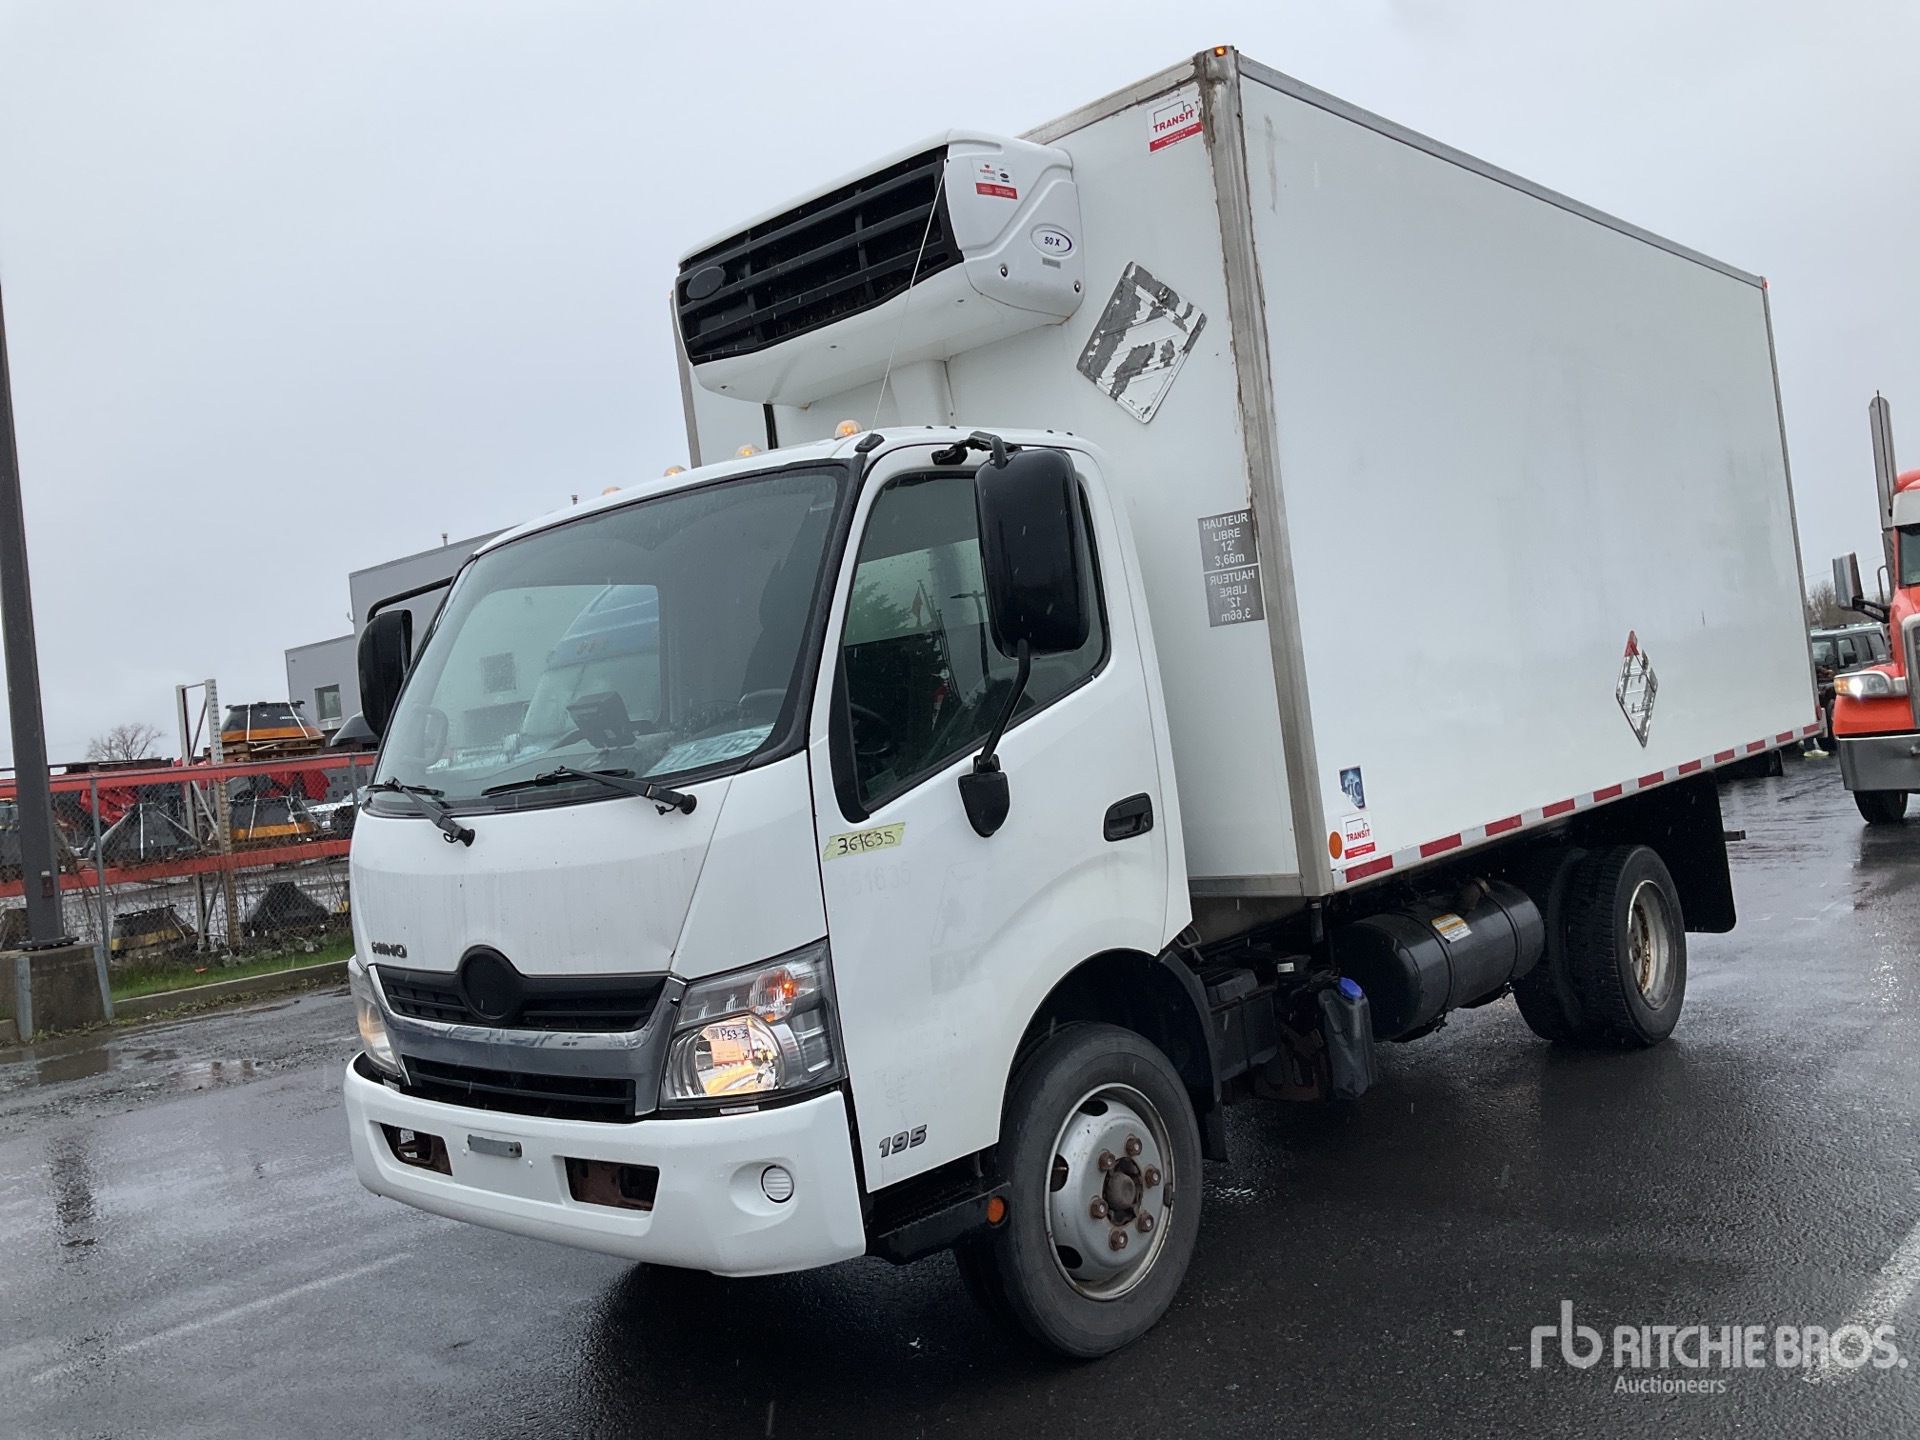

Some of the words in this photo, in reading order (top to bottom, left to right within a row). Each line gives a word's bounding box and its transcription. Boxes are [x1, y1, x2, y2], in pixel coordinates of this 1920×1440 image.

[1153, 109, 1194, 133] TRANSIT
[1044, 236, 1054, 245] 50
[1054, 238, 1061, 247] X
[1203, 512, 1248, 530] HAUTEUR
[1213, 528, 1241, 542] LIBRE
[1215, 553, 1245, 568] 3,66m
[837, 830, 896, 856] 361635
[1346, 829, 1370, 842] TRANSIT
[371, 941, 408, 959] HINO
[879, 1124, 928, 1158] 195
